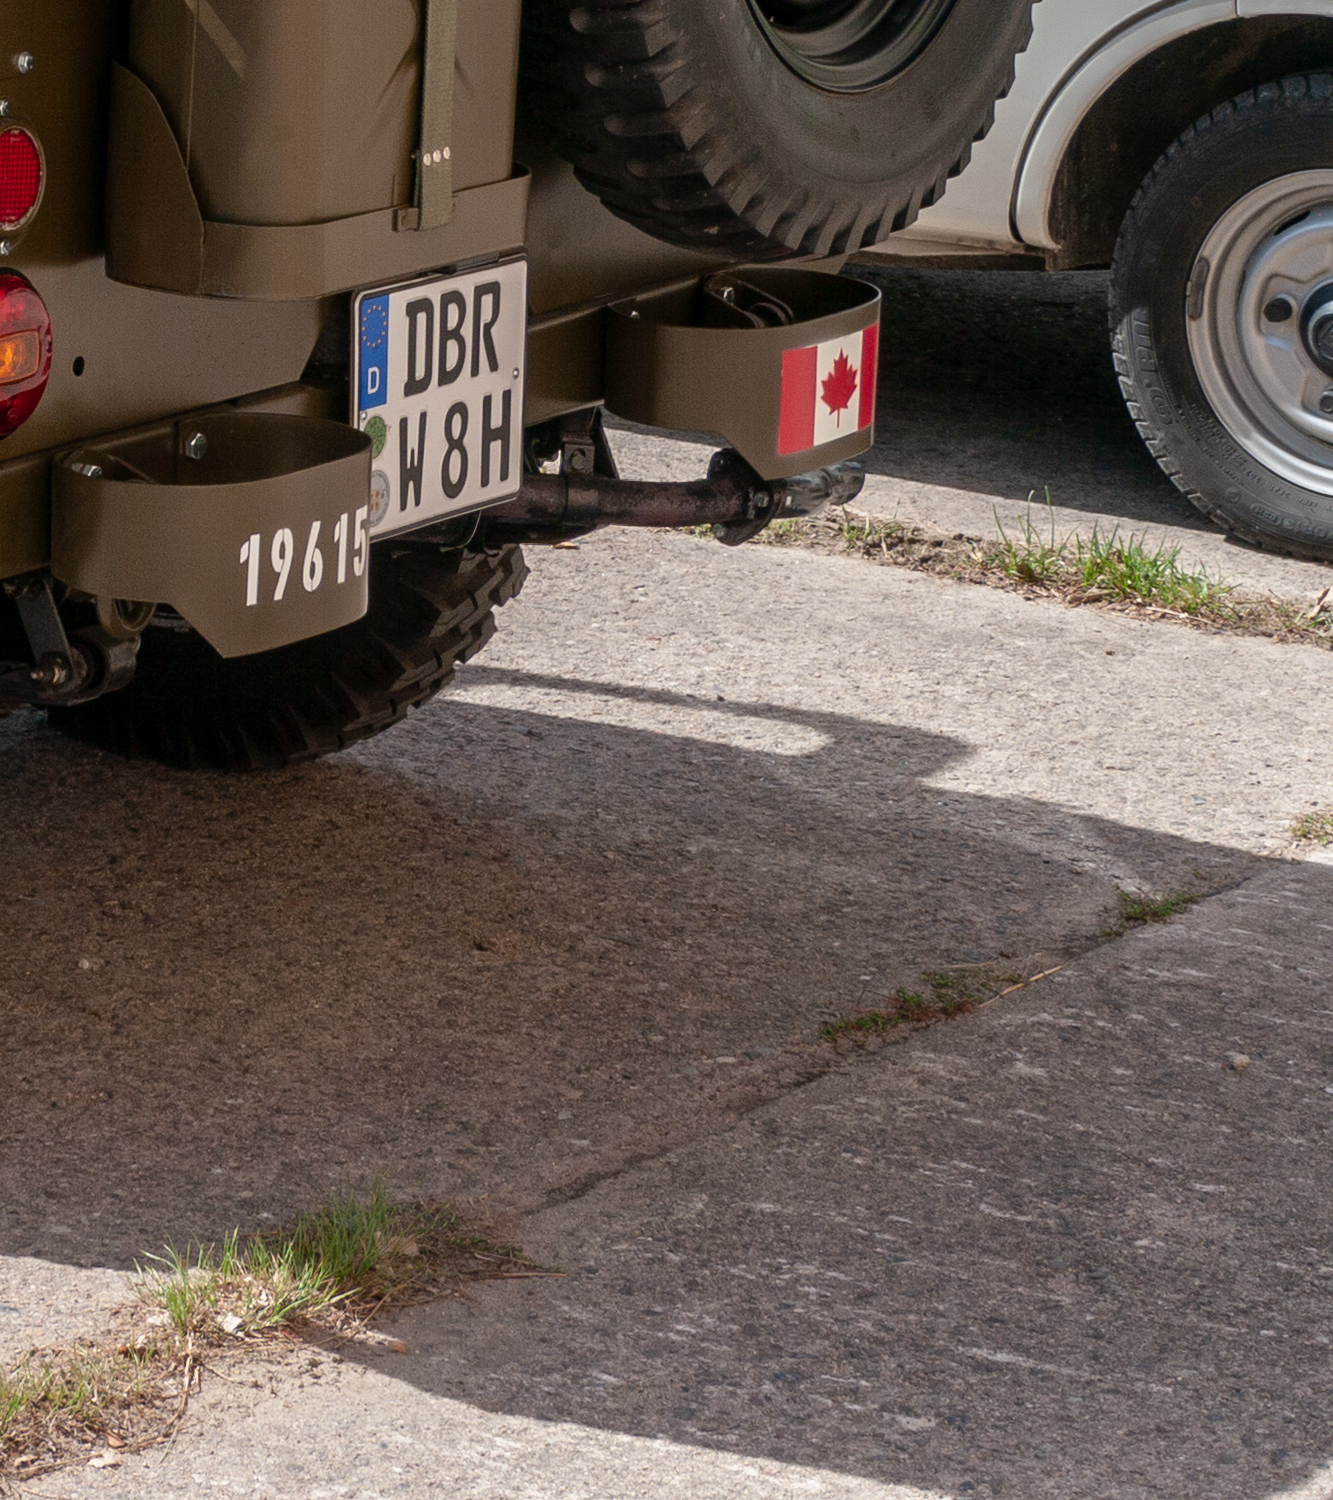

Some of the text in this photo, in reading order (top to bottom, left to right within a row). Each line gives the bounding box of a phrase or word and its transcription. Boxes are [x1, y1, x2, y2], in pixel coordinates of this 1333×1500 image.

[367, 366, 380, 395] D
[403, 280, 502, 398] DBR
[239, 504, 369, 607] 19615
